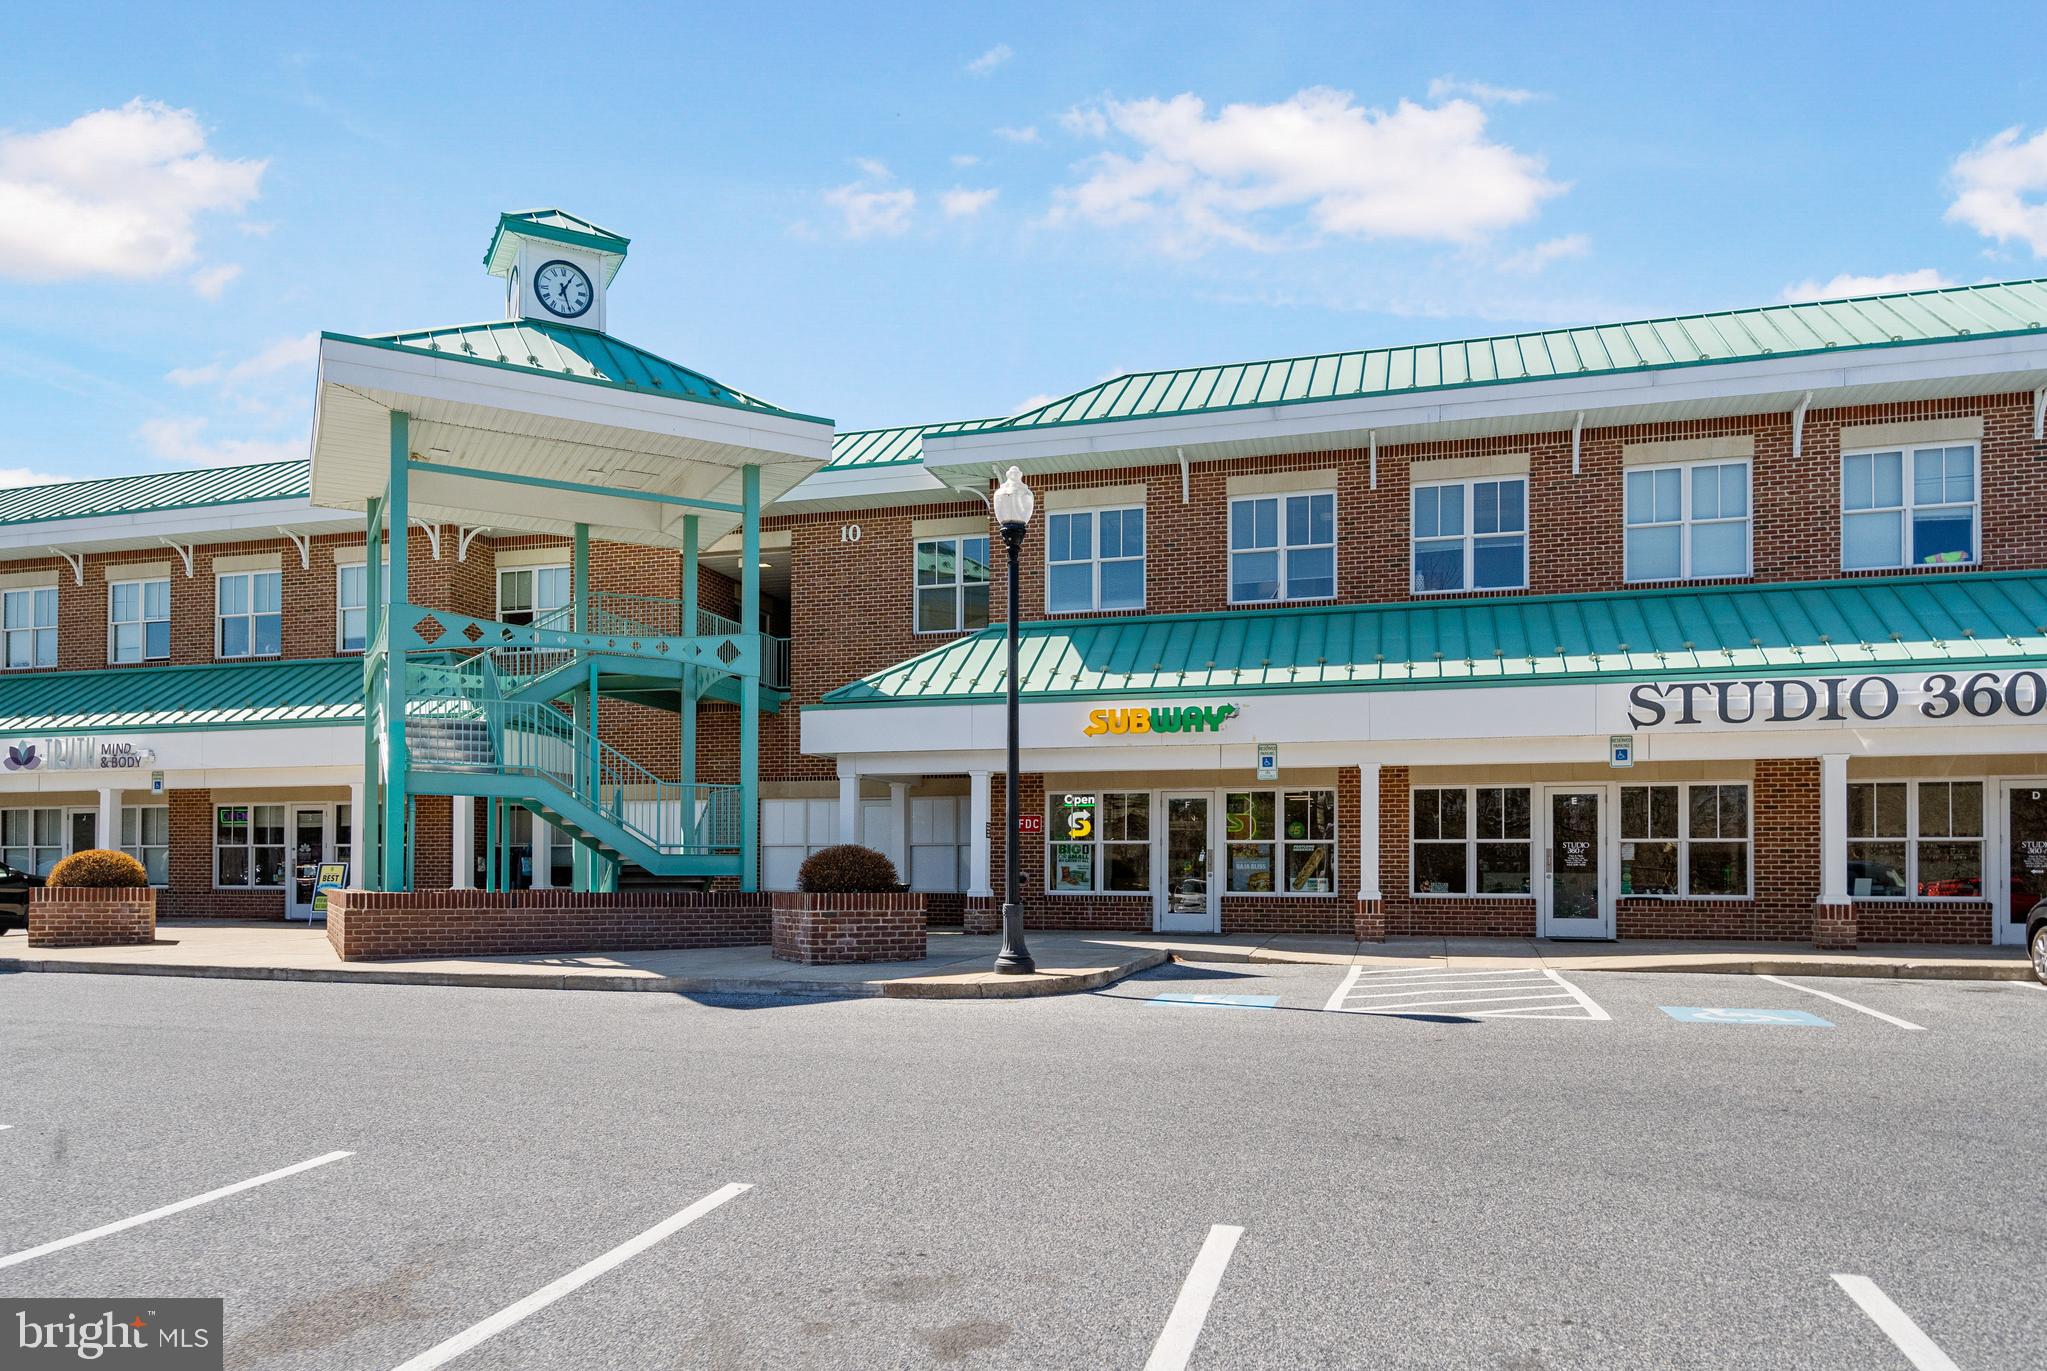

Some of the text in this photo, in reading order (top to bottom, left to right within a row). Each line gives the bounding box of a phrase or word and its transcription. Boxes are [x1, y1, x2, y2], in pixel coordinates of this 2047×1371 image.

[841, 524, 861, 542] 10
[1628, 671, 2047, 730] STUDIO 360
[1083, 703, 1236, 737] SUBWAY
[101, 743, 132, 755] MIND
[1571, 797, 1578, 805] E
[2032, 791, 2041, 800] D
[1018, 819, 1039, 829] FDC
